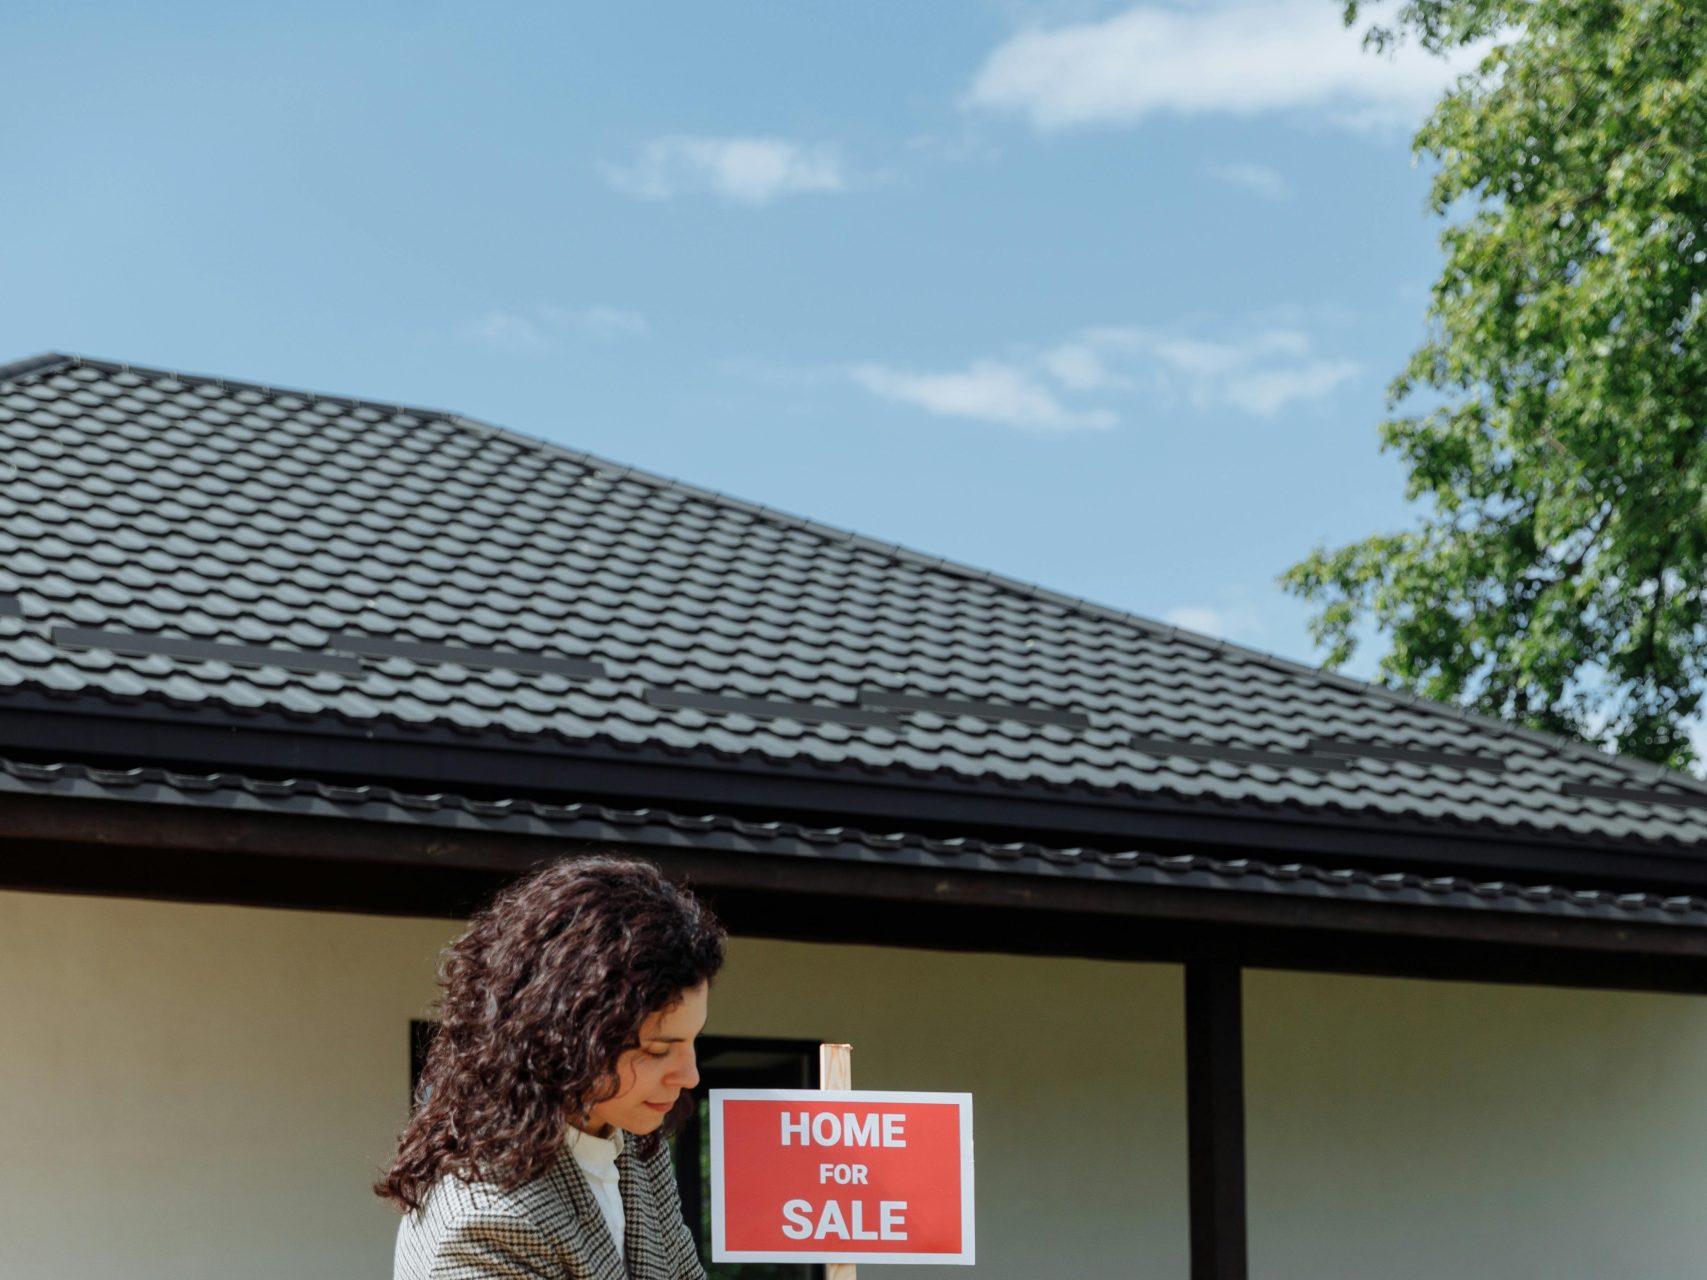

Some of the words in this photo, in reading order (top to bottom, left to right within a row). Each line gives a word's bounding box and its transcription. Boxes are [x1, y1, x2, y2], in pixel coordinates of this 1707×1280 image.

[780, 1111, 907, 1148] HOME
[819, 1163, 869, 1185] FOR
[781, 1199, 908, 1241] SALE
